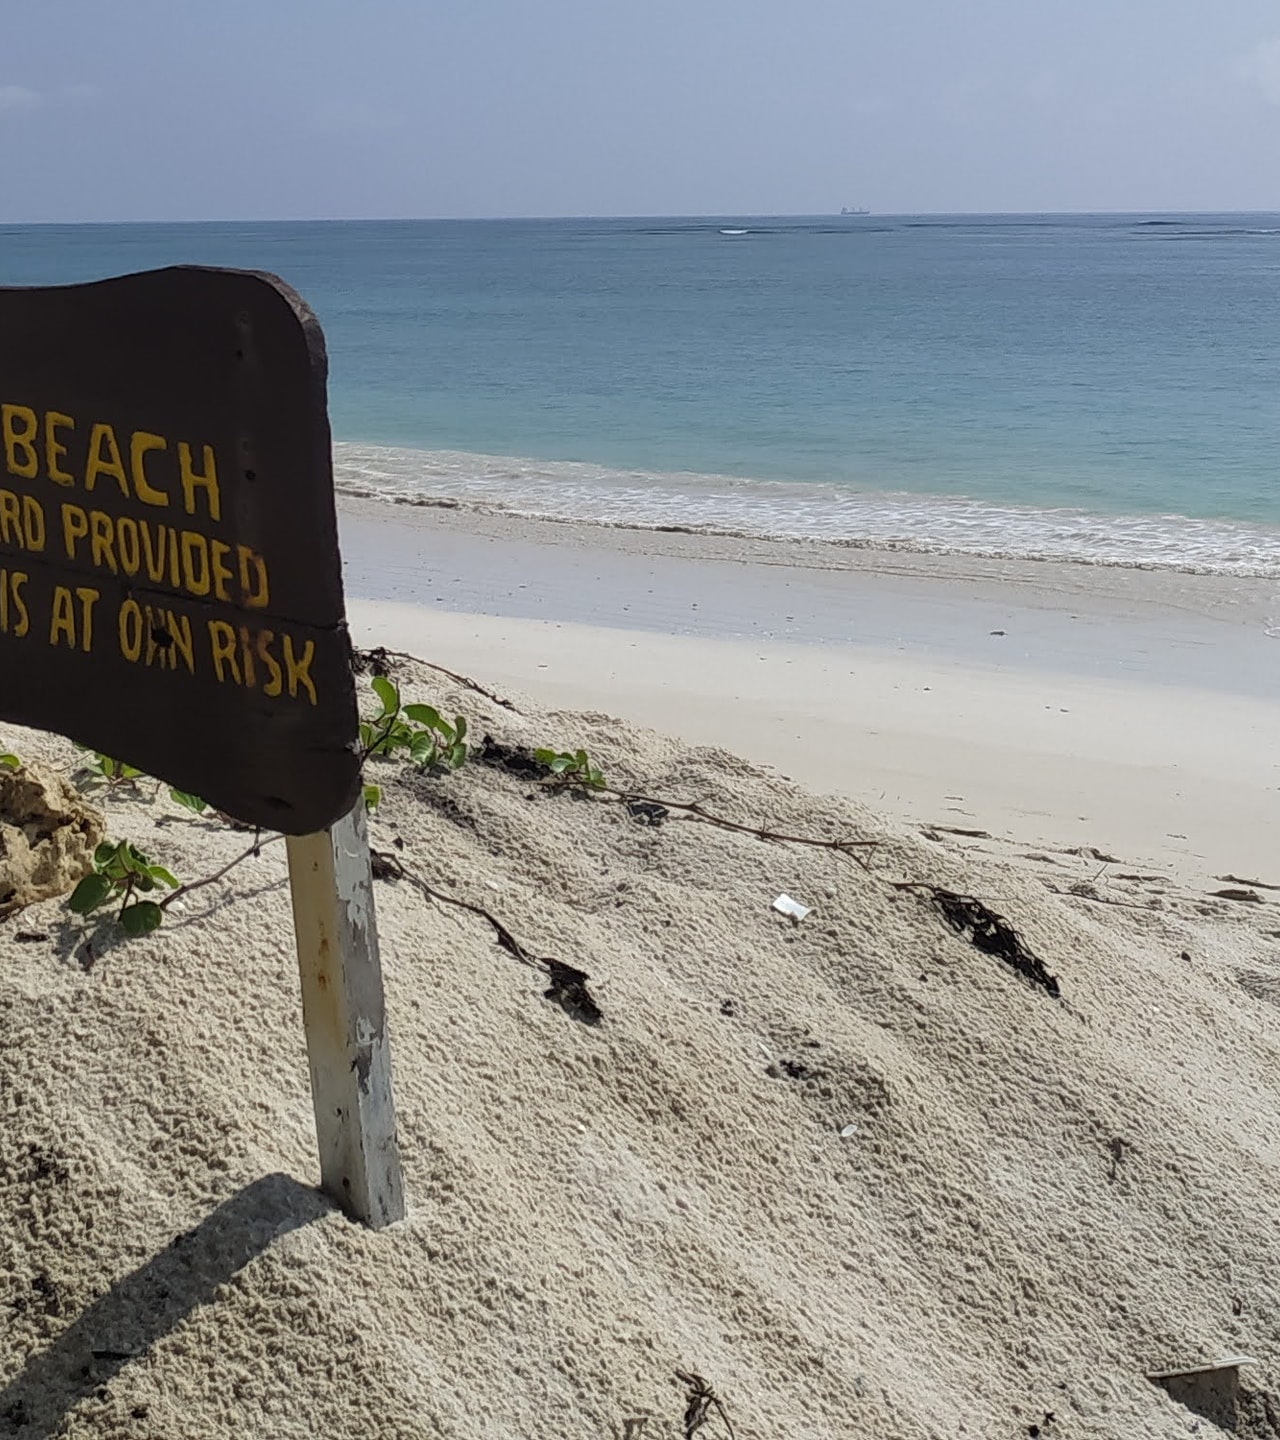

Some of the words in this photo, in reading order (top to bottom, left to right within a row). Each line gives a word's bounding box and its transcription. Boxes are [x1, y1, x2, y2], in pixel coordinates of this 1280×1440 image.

[1, 403, 220, 521] BEACH
[62, 503, 269, 608] PROVIDED
[0, 568, 28, 637] IS
[50, 586, 99, 652] AT
[209, 618, 318, 705] RISK
